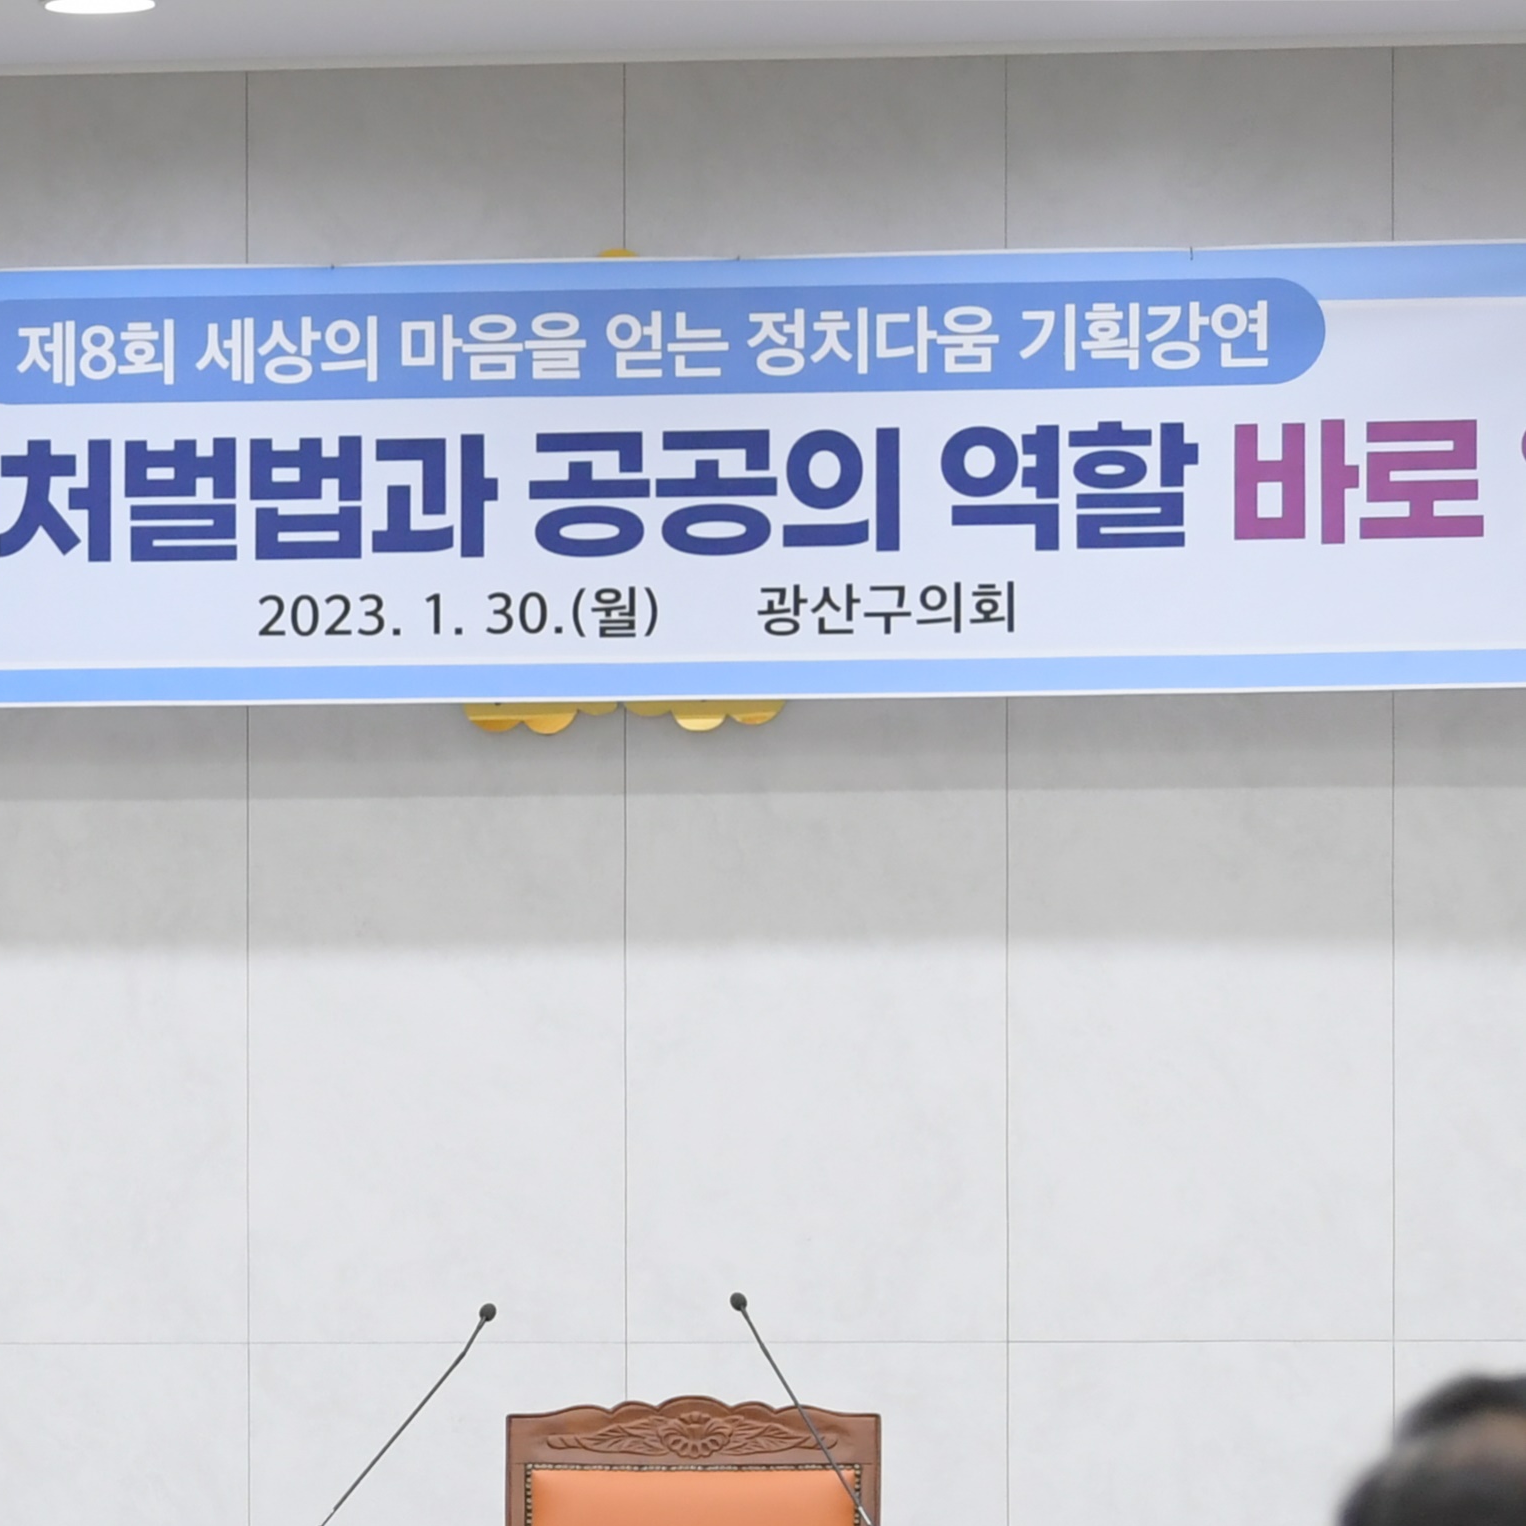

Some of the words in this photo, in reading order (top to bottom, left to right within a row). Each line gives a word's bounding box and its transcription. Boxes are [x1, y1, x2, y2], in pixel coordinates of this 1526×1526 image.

[17, 319, 174, 387] 제8회
[196, 316, 378, 384] 세상의
[401, 313, 586, 381] 마음을
[606, 312, 729, 378] 얻는
[747, 307, 1000, 376] 정치다움
[1020, 300, 1271, 371] 기획강연
[528, 427, 901, 558] 공공의
[940, 420, 1199, 551] 역할
[1234, 418, 1484, 545] 바로
[258, 594, 401, 637] 2023.
[425, 594, 463, 636] 1.
[486, 586, 658, 639] 30.(월)
[757, 580, 1015, 637] 광산구의회
